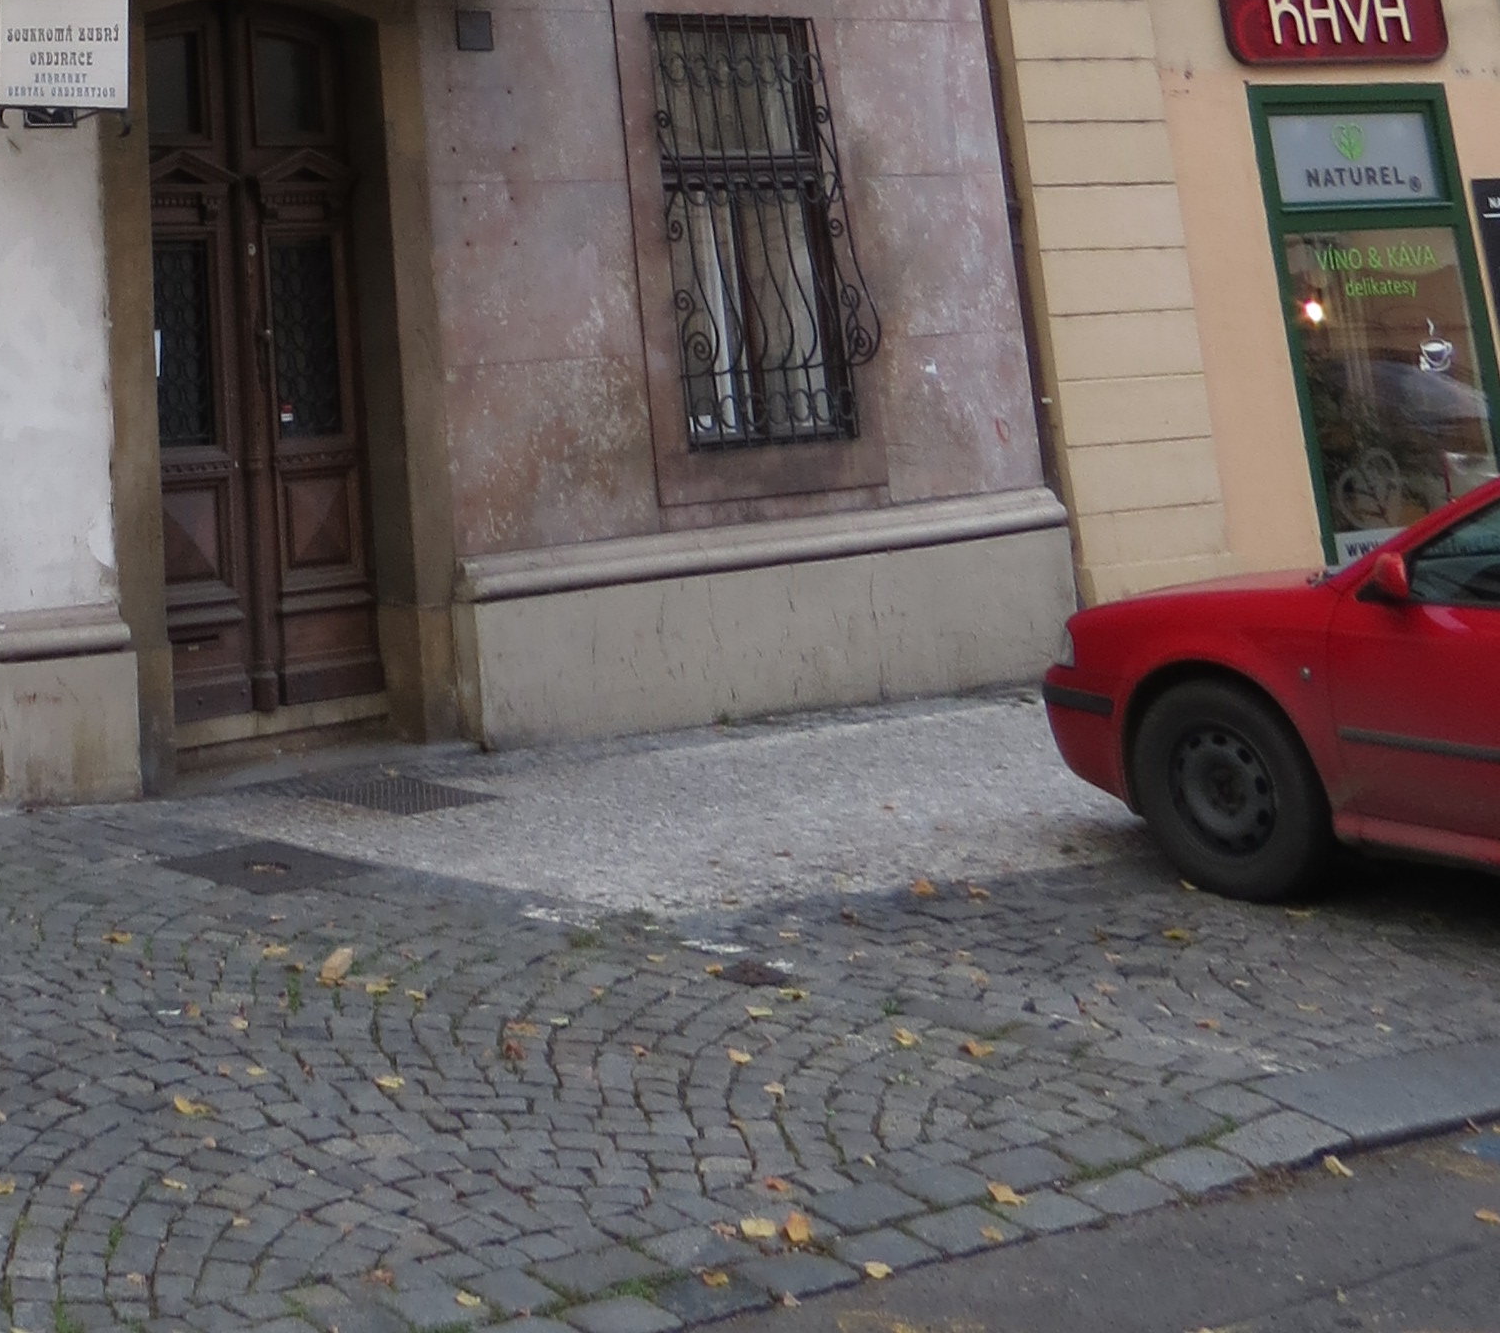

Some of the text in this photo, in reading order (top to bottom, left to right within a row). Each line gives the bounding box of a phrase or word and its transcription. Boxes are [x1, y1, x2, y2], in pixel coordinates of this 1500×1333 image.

[30, 51, 93, 66] ORDINACE
[1305, 166, 1406, 188] NATUREL
[1315, 241, 1438, 271] VÍNO & KÁVA
[1345, 278, 1418, 298] delikatesy
